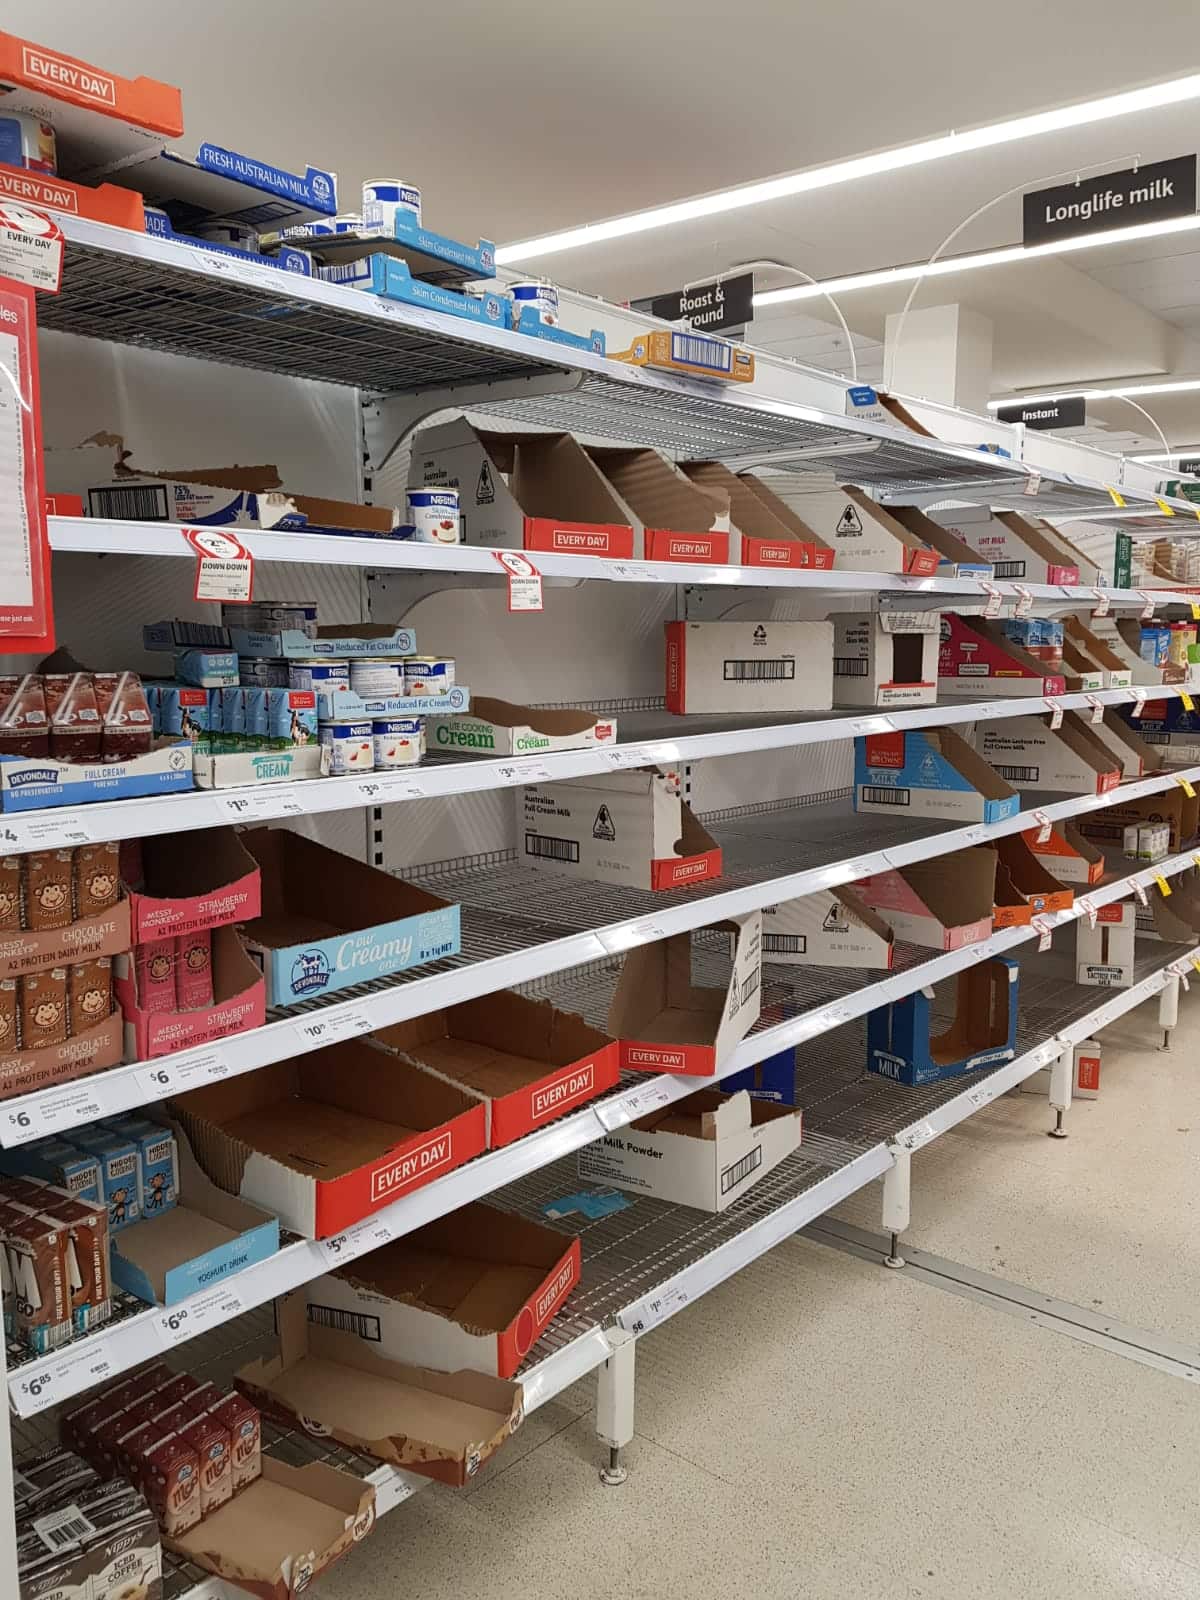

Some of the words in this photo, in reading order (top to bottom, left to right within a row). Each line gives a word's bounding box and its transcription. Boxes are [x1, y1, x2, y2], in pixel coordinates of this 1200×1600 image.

[29, 56, 78, 87] EVERY
[80, 74, 109, 98] DAY
[203, 148, 234, 170] FRESH
[234, 158, 288, 189] AUSTRALIAN
[288, 180, 310, 198] MILK
[43, 188, 72, 207] DAY
[1045, 191, 1124, 224] Longlife
[1129, 178, 1175, 204] milk
[7, 231, 33, 245] EVERY
[34, 239, 52, 249] DAY
[418, 236, 433, 247] Skim
[433, 241, 466, 261] Condensed
[412, 285, 430, 299] Skim
[430, 291, 467, 312] Condensed
[467, 303, 481, 314] Milk
[679, 296, 713, 313] Roast
[714, 287, 725, 302] &
[1022, 408, 1059, 421] Instant
[557, 534, 586, 545] EVERY
[587, 536, 605, 547] DAY
[672, 542, 694, 553] EVERY
[695, 543, 709, 555] DAY
[762, 550, 776, 559] EVERY
[777, 550, 788, 561] DAY
[202, 562, 225, 571] DOWN
[226, 563, 248, 572] DOWN
[387, 699, 417, 710] Reduced
[436, 723, 495, 749] Cream
[461, 722, 493, 734] COOKING
[516, 736, 550, 750] Cream
[10, 770, 58, 785] DEVONDALE
[84, 768, 101, 779] FULL
[101, 767, 126, 778] CREAM
[256, 761, 290, 780] CREAM
[674, 866, 693, 878] EVERY
[693, 863, 707, 874] DAY
[198, 893, 248, 913] STRAWBERRY
[146, 908, 173, 919] MESSY
[168, 918, 199, 934] PROTEIN
[199, 914, 217, 927] DAIRY
[218, 911, 236, 923] MILK
[62, 922, 117, 943] CHOCOLATE
[21, 953, 56, 967] PROTEIN
[57, 947, 80, 961] DAIRY
[81, 943, 102, 956] MILK
[335, 936, 413, 973] Creamy
[293, 973, 328, 992] DEVONDALE
[207, 1003, 255, 1025] STRAWBERRY
[180, 1031, 208, 1048] PROTEIN
[227, 1020, 244, 1033] MILK
[57, 1035, 112, 1059] CHOCOLATE
[632, 1051, 661, 1063] EVERY
[662, 1053, 681, 1065] DAY
[15, 1070, 51, 1088] PROTEIN
[51, 1063, 73, 1077] DAIRY
[73, 1056, 94, 1069] MILK
[151, 1070, 170, 1085] $6
[878, 1059, 900, 1081] MILK
[535, 1085, 569, 1112] EVERY
[569, 1071, 590, 1093] DAY
[8, 1111, 31, 1128] $6
[603, 1136, 625, 1151] Milk
[626, 1142, 664, 1160] Powder
[376, 1159, 418, 1193] EVERY
[420, 1142, 447, 1168] DAY
[538, 1286, 559, 1318] EVERY
[558, 1265, 573, 1293] DAY
[16, 1298, 35, 1318] GO
[632, 1320, 644, 1333] 56
[107, 1558, 143, 1584] COFFEE
[114, 1553, 136, 1570] ICED
